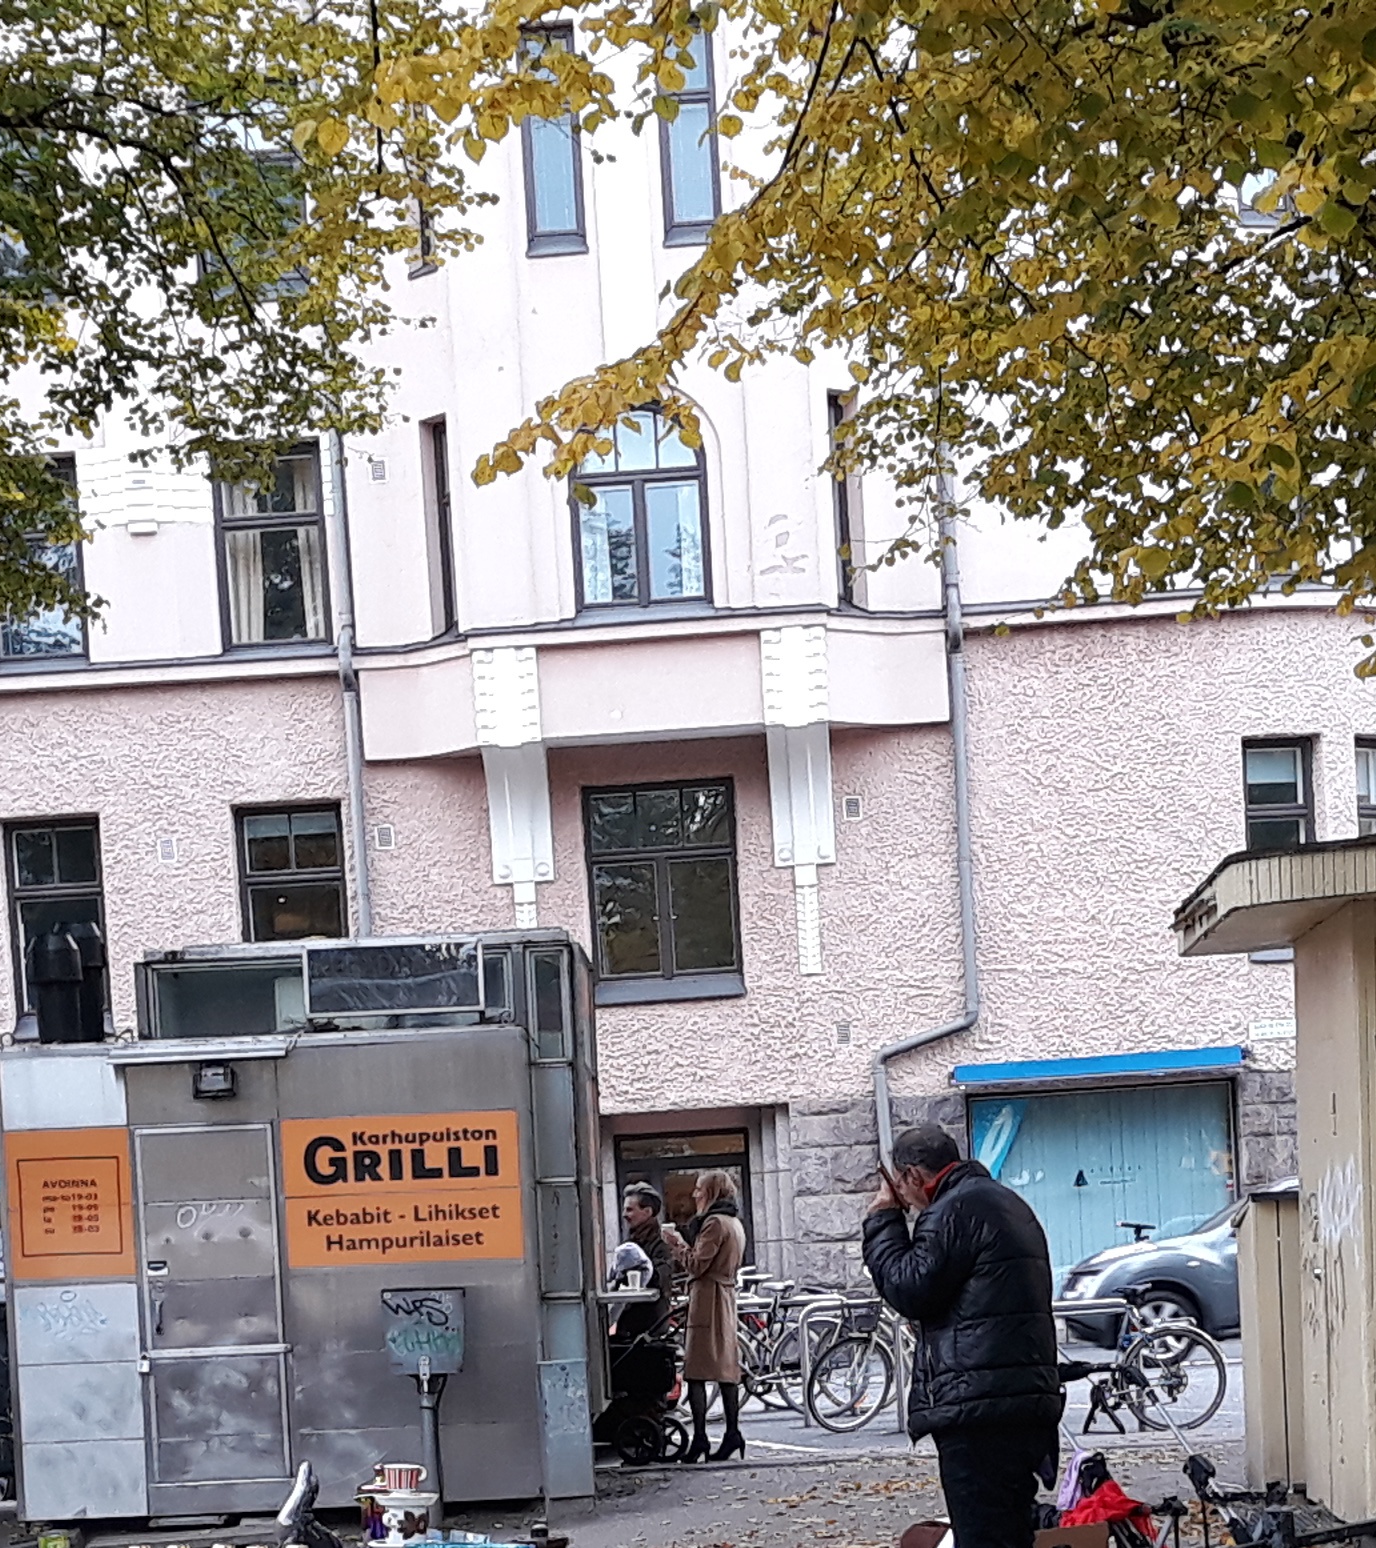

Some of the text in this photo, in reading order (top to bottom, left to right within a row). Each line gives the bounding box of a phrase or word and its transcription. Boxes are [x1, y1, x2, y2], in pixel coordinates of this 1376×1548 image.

[351, 1127, 498, 1148] Karhupuiston
[303, 1135, 500, 1186] GRILLI
[306, 1206, 393, 1227] Kebabit
[413, 1203, 501, 1223] Lihikset
[325, 1229, 485, 1255] Hampurilaiset
